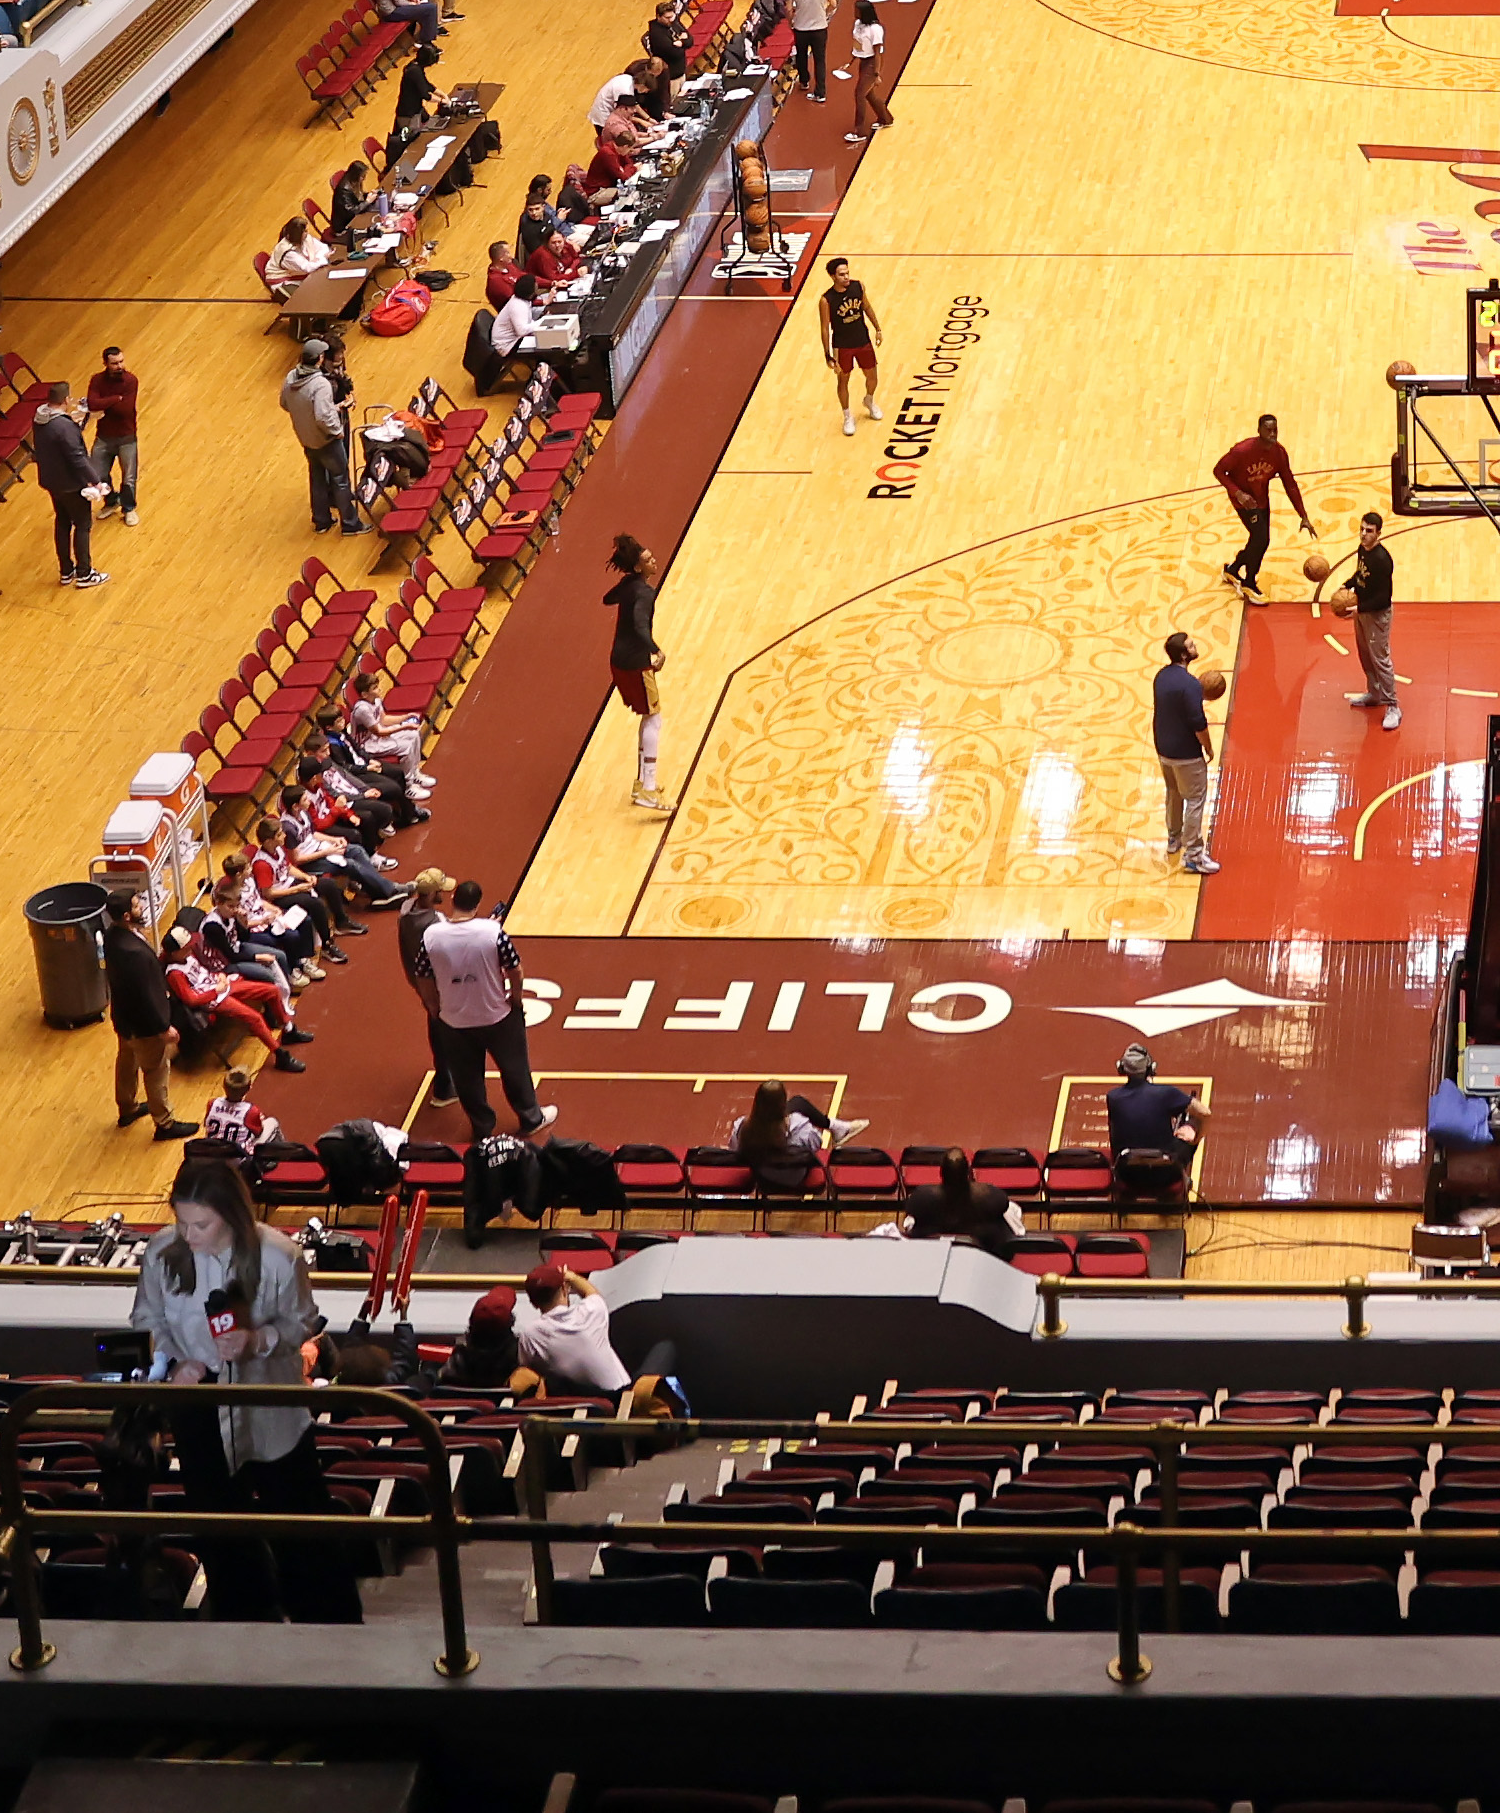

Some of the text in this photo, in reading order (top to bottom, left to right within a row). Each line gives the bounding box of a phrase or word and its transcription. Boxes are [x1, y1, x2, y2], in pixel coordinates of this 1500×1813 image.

[866, 294, 990, 500] ROCKET Mortgage
[510, 977, 1013, 1035] CLIFFS
[208, 1119, 239, 1141] 20
[211, 1313, 234, 1334] 19
